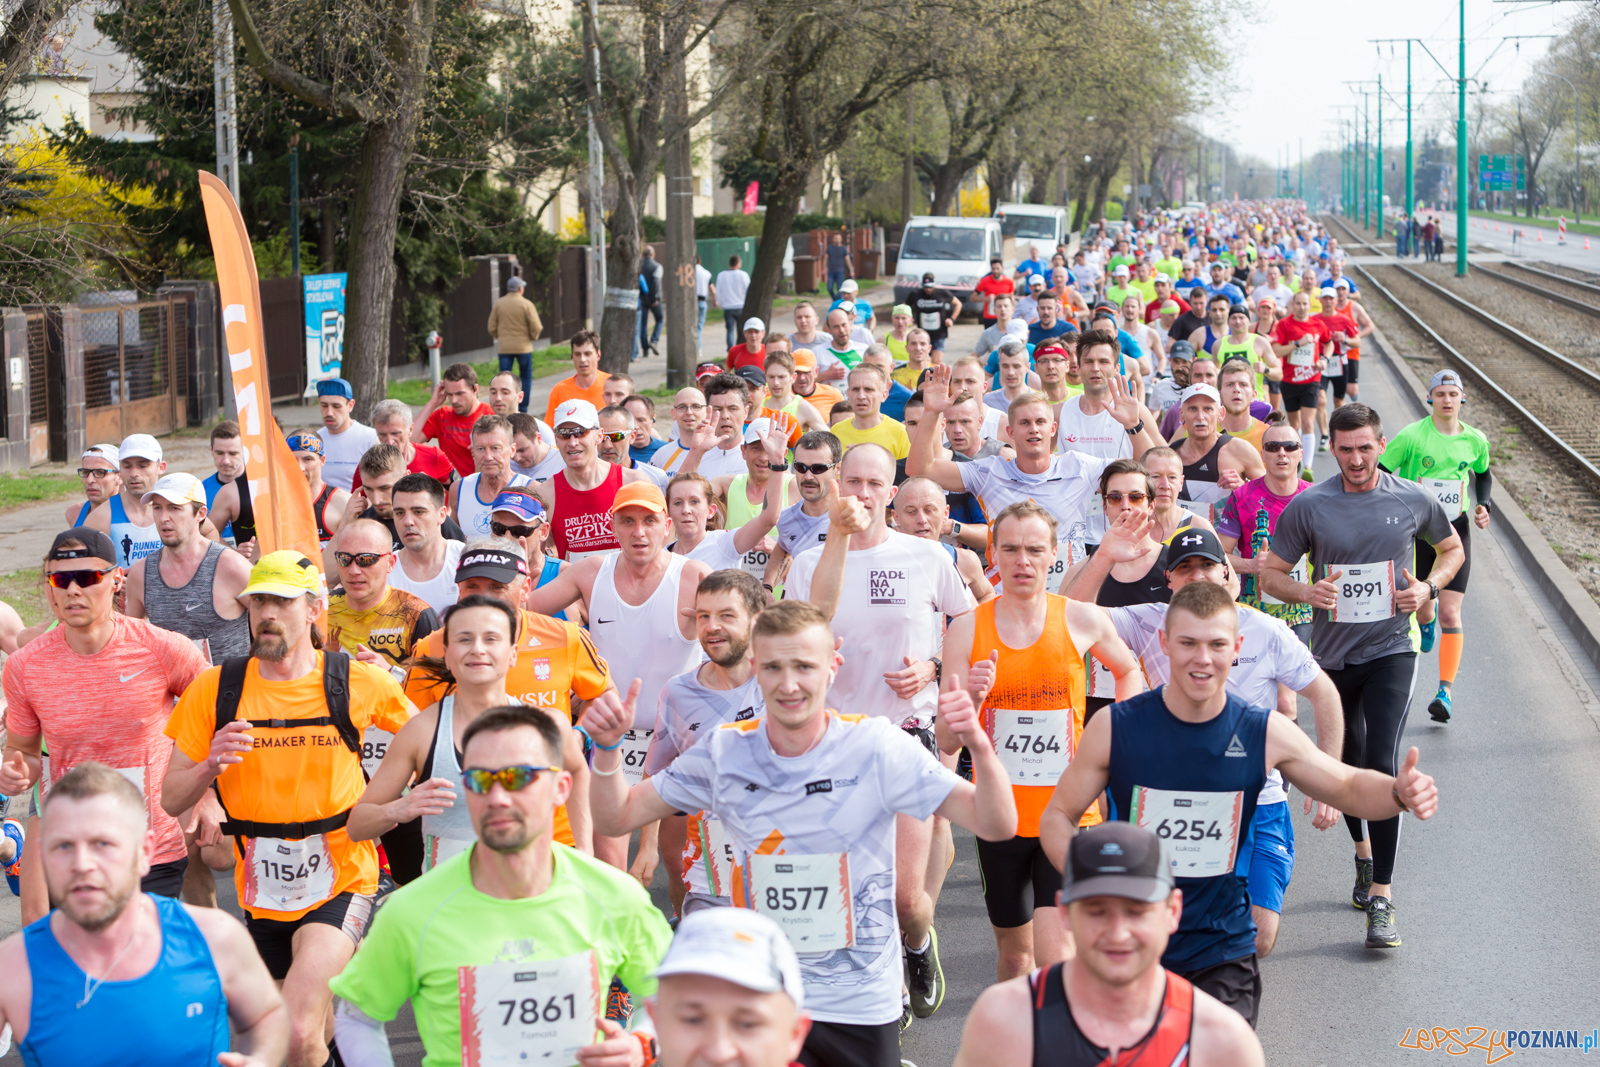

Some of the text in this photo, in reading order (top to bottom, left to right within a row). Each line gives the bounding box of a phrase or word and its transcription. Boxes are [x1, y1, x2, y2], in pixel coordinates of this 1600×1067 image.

[675, 263, 695, 287] 18
[463, 554, 511, 567] DAILY
[870, 570, 906, 579] PADŁ
[870, 579, 890, 588] NA
[870, 588, 895, 597] RYJ
[1342, 581, 1382, 598] 8991
[1005, 735, 1060, 754] 4764
[1156, 818, 1222, 841] 6254
[261, 853, 321, 882] 11549
[766, 886, 829, 911] 8577
[498, 993, 575, 1026] 7861
